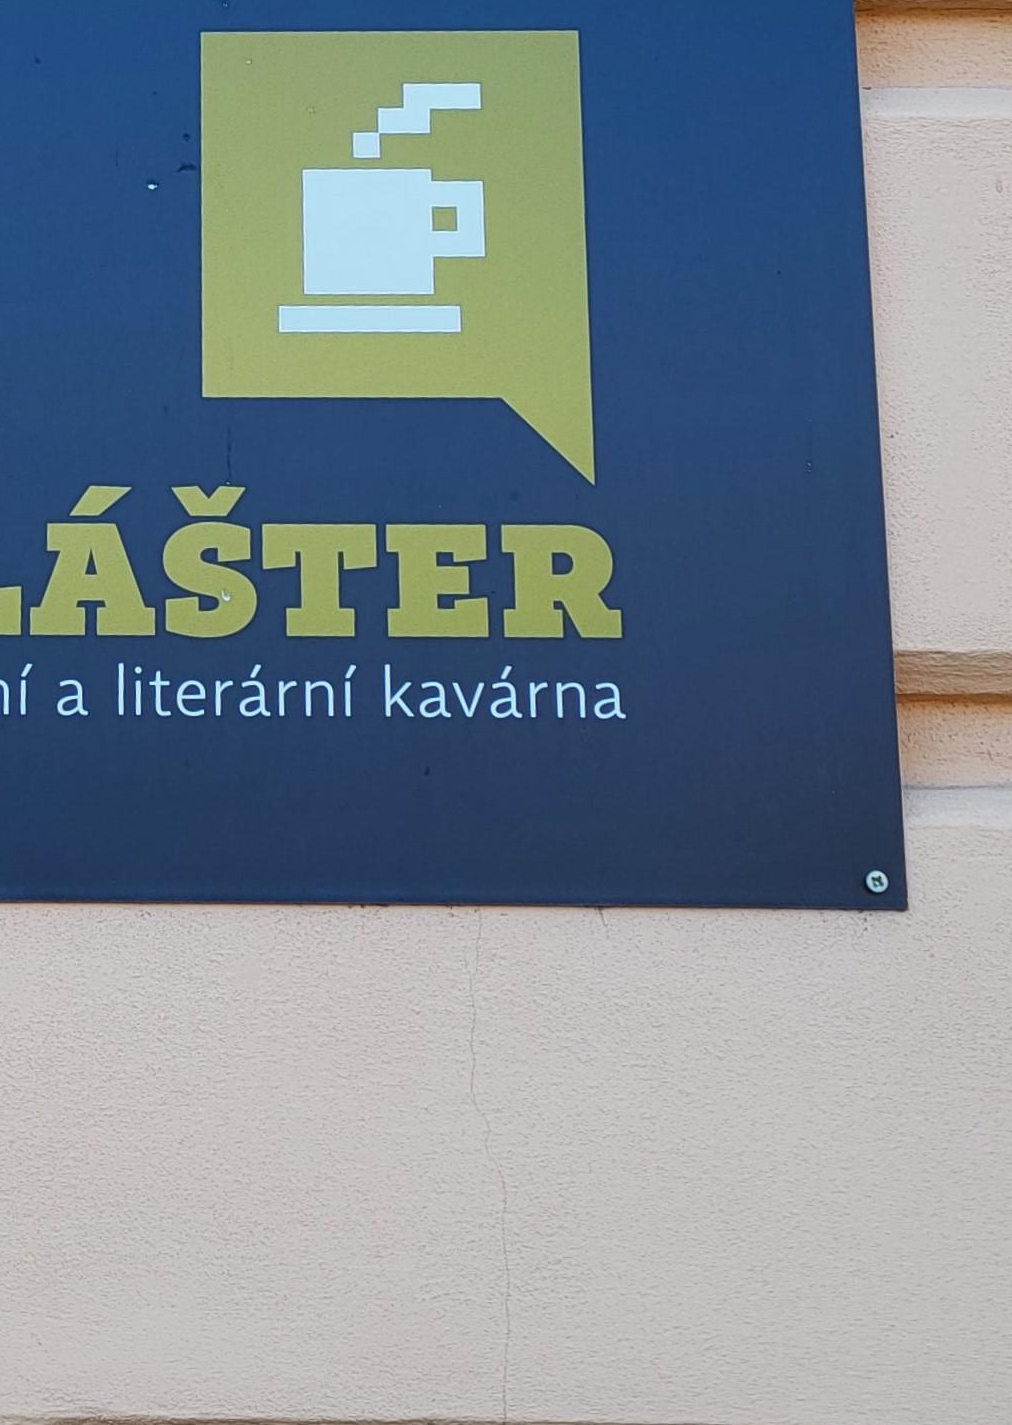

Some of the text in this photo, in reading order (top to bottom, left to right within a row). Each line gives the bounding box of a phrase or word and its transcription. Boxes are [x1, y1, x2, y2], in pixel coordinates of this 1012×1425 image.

[56, 679, 89, 716] a
[117, 662, 357, 717] literární
[384, 663, 627, 720] kavárna
